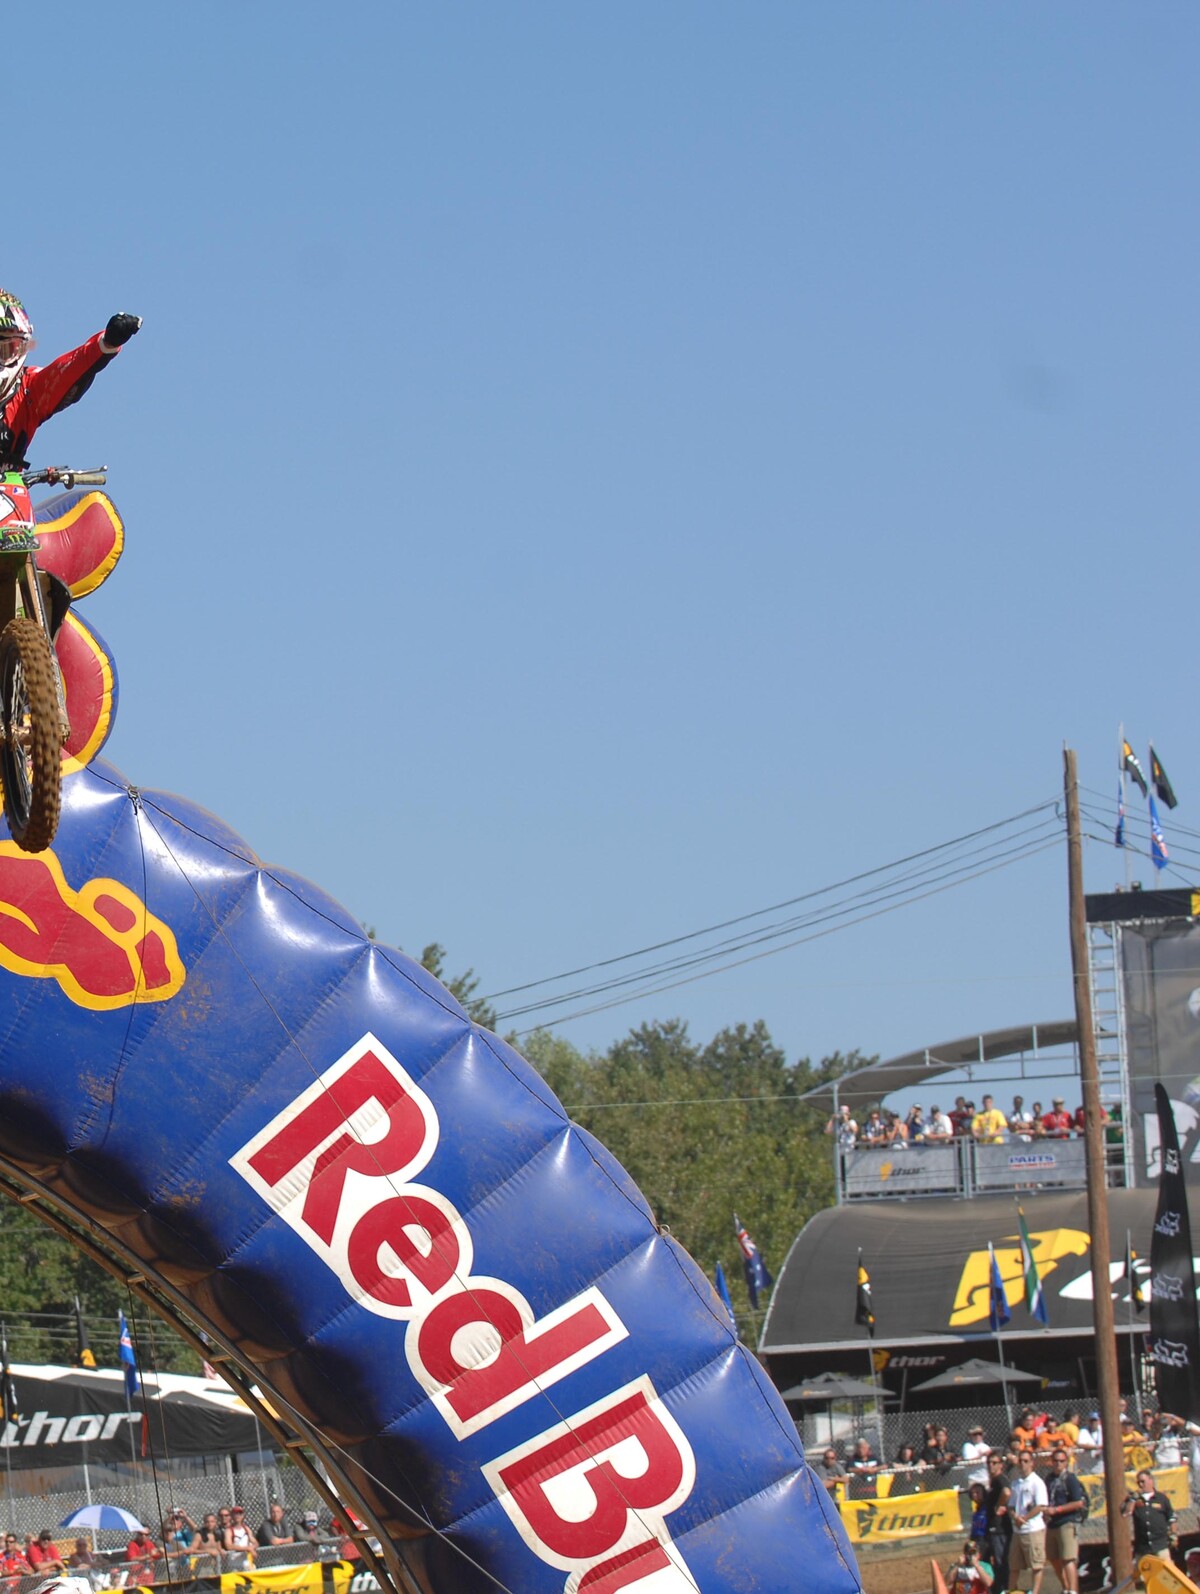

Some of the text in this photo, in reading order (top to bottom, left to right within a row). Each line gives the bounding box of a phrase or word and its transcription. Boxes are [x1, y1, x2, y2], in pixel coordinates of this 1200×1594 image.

[234, 1038, 623, 1436] Red
[889, 1355, 946, 1368] thor
[0, 1411, 143, 1447] thor
[876, 1510, 945, 1532] thor
